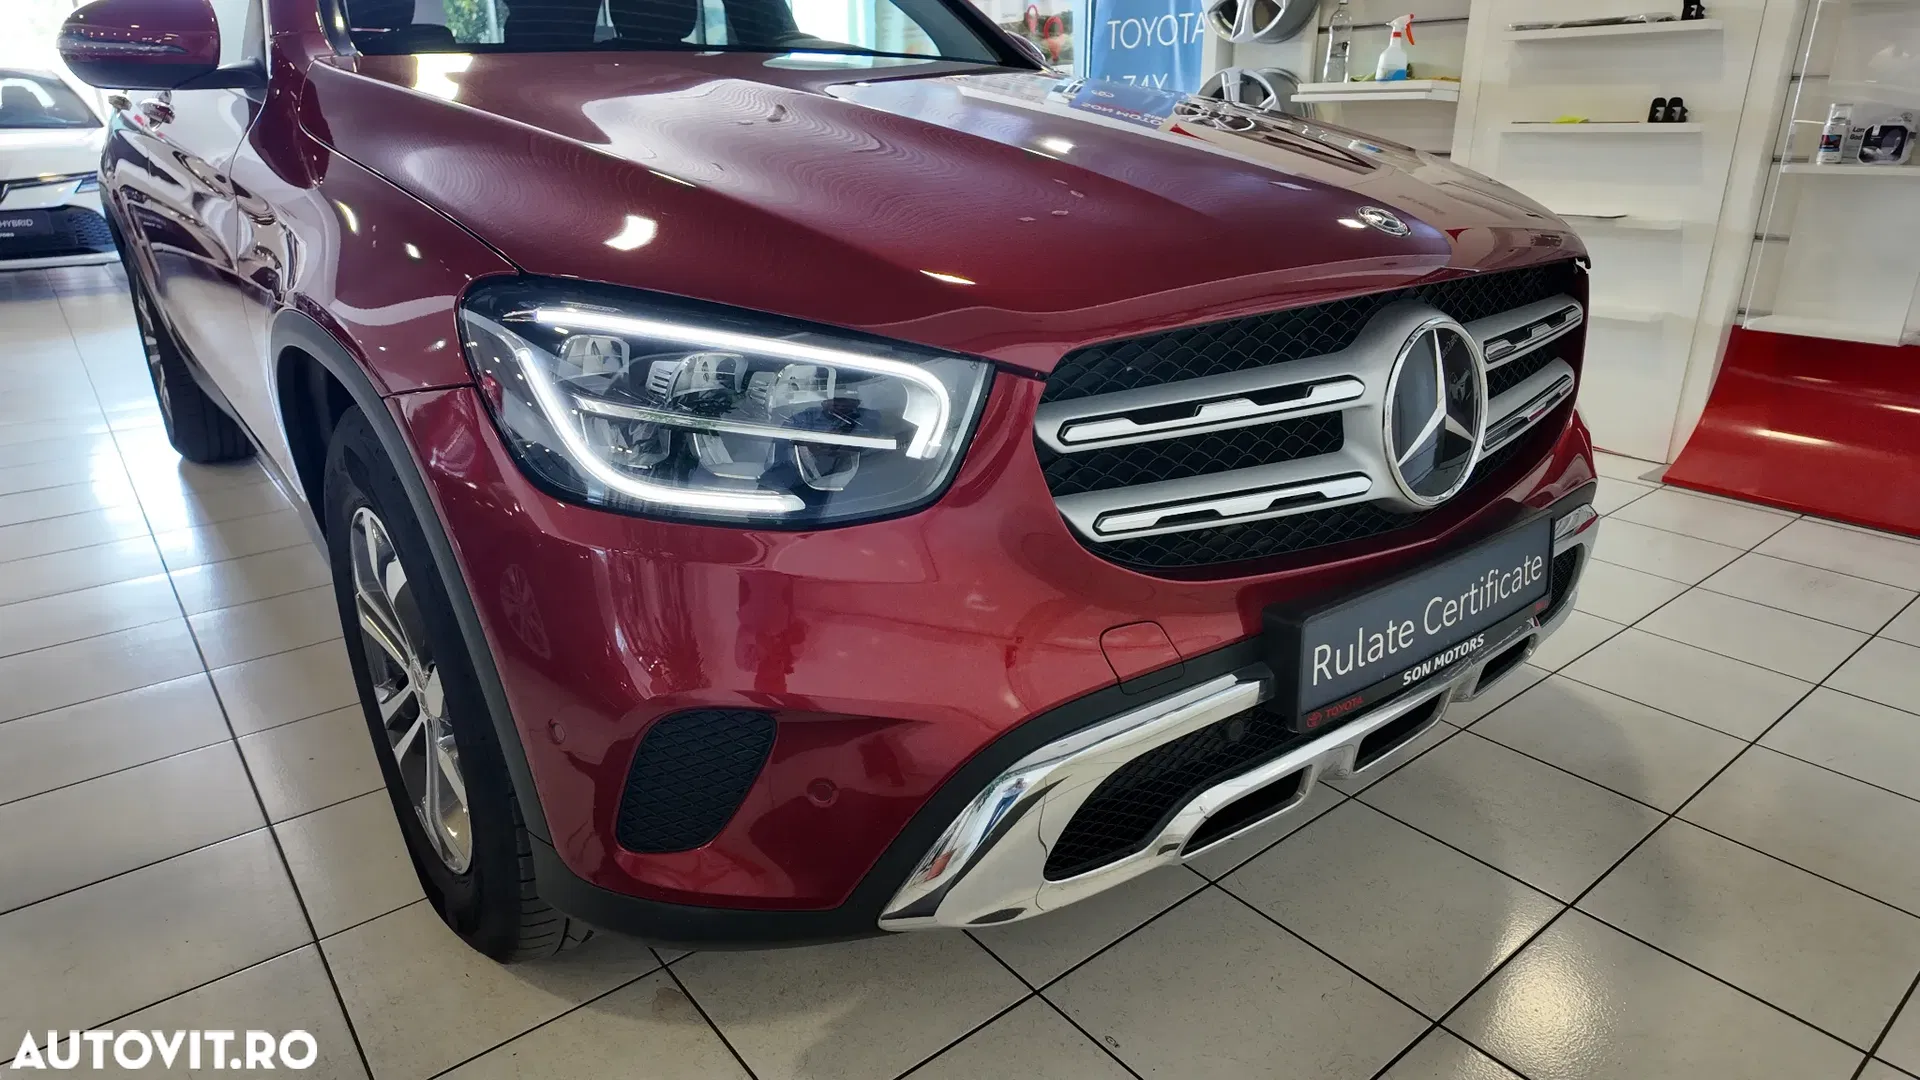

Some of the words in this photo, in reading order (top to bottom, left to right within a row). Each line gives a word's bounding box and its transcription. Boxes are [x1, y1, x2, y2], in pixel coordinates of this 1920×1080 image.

[1107, 11, 1205, 49] TOYOTA
[1312, 619, 1414, 686] Rulate
[1423, 554, 1543, 636] Certificate
[1403, 659, 1431, 686] SON
[1433, 633, 1485, 671] MOTORS
[1325, 696, 1364, 717] TOYOTA
